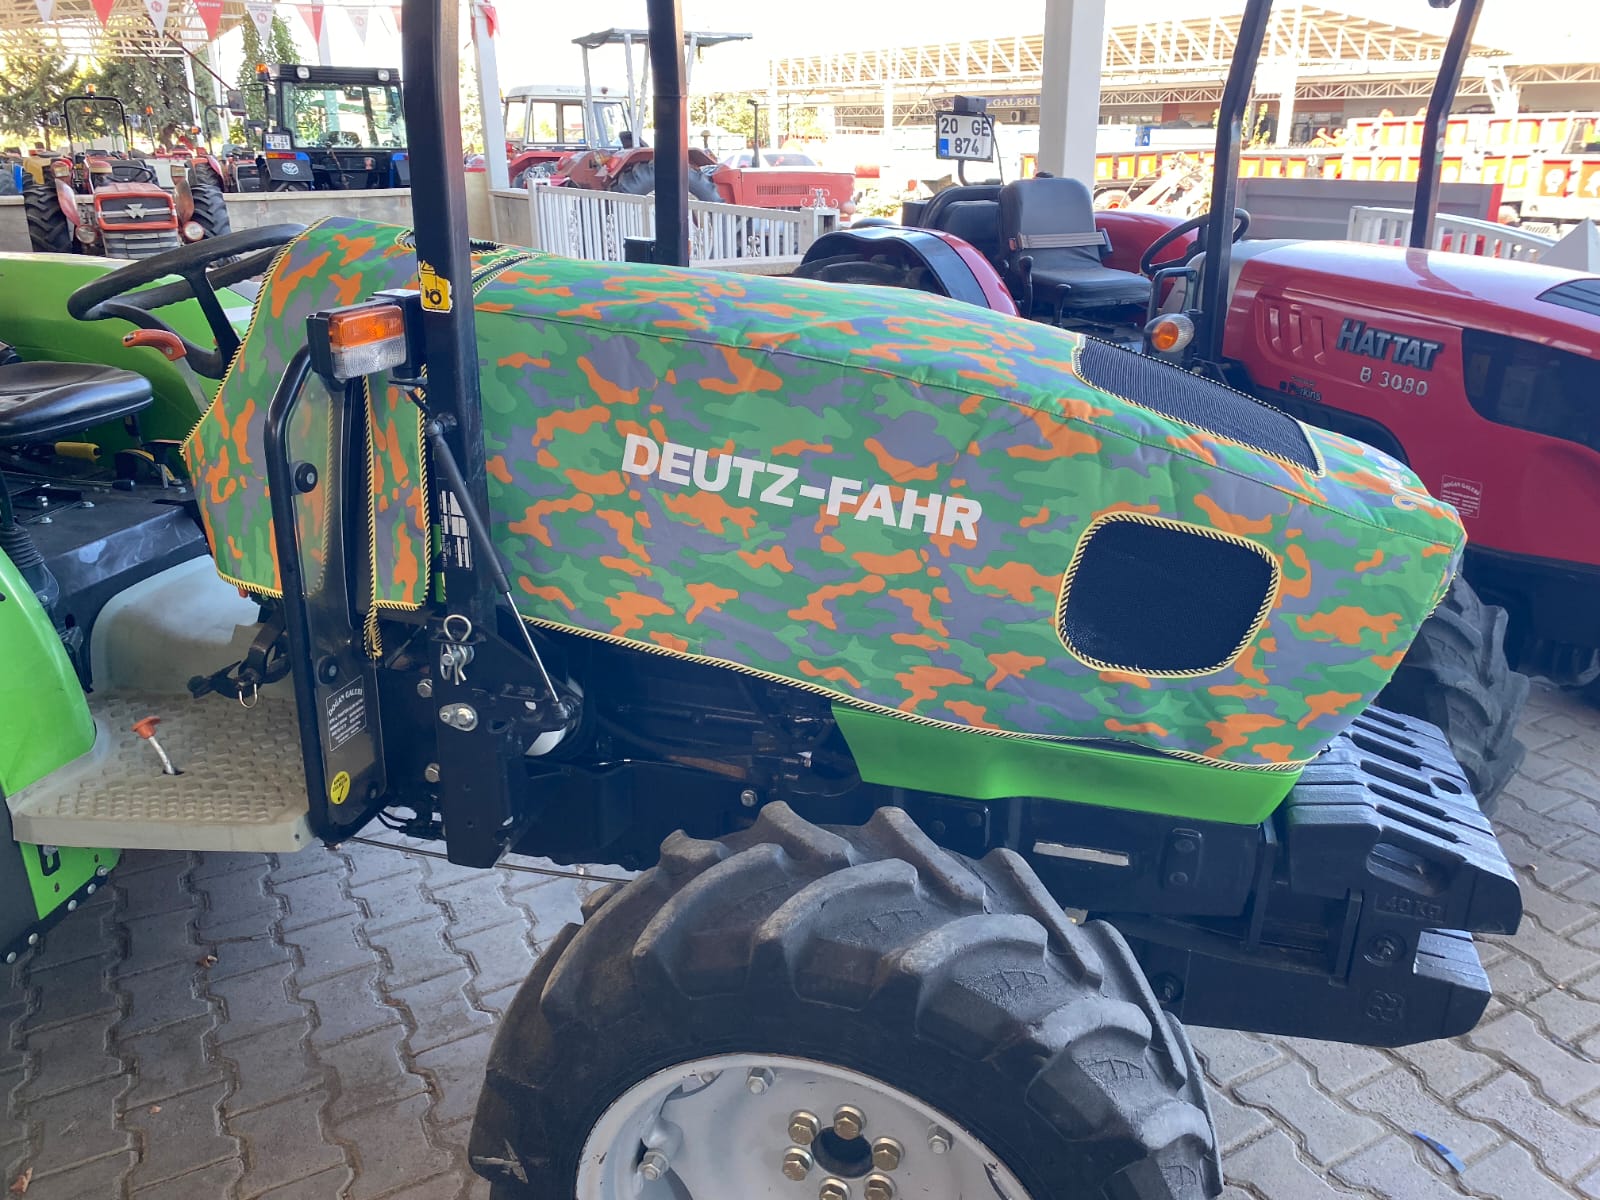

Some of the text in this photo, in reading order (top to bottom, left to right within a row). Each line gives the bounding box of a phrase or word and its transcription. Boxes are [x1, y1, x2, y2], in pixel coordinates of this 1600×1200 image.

[992, 95, 1037, 106] GALERİ
[941, 118, 990, 136] 20 GE
[954, 138, 979, 155] 874
[1335, 318, 1445, 371] HATTAT
[1359, 366, 1428, 396] B 3080
[621, 433, 982, 541] DEUTZ-FAHR
